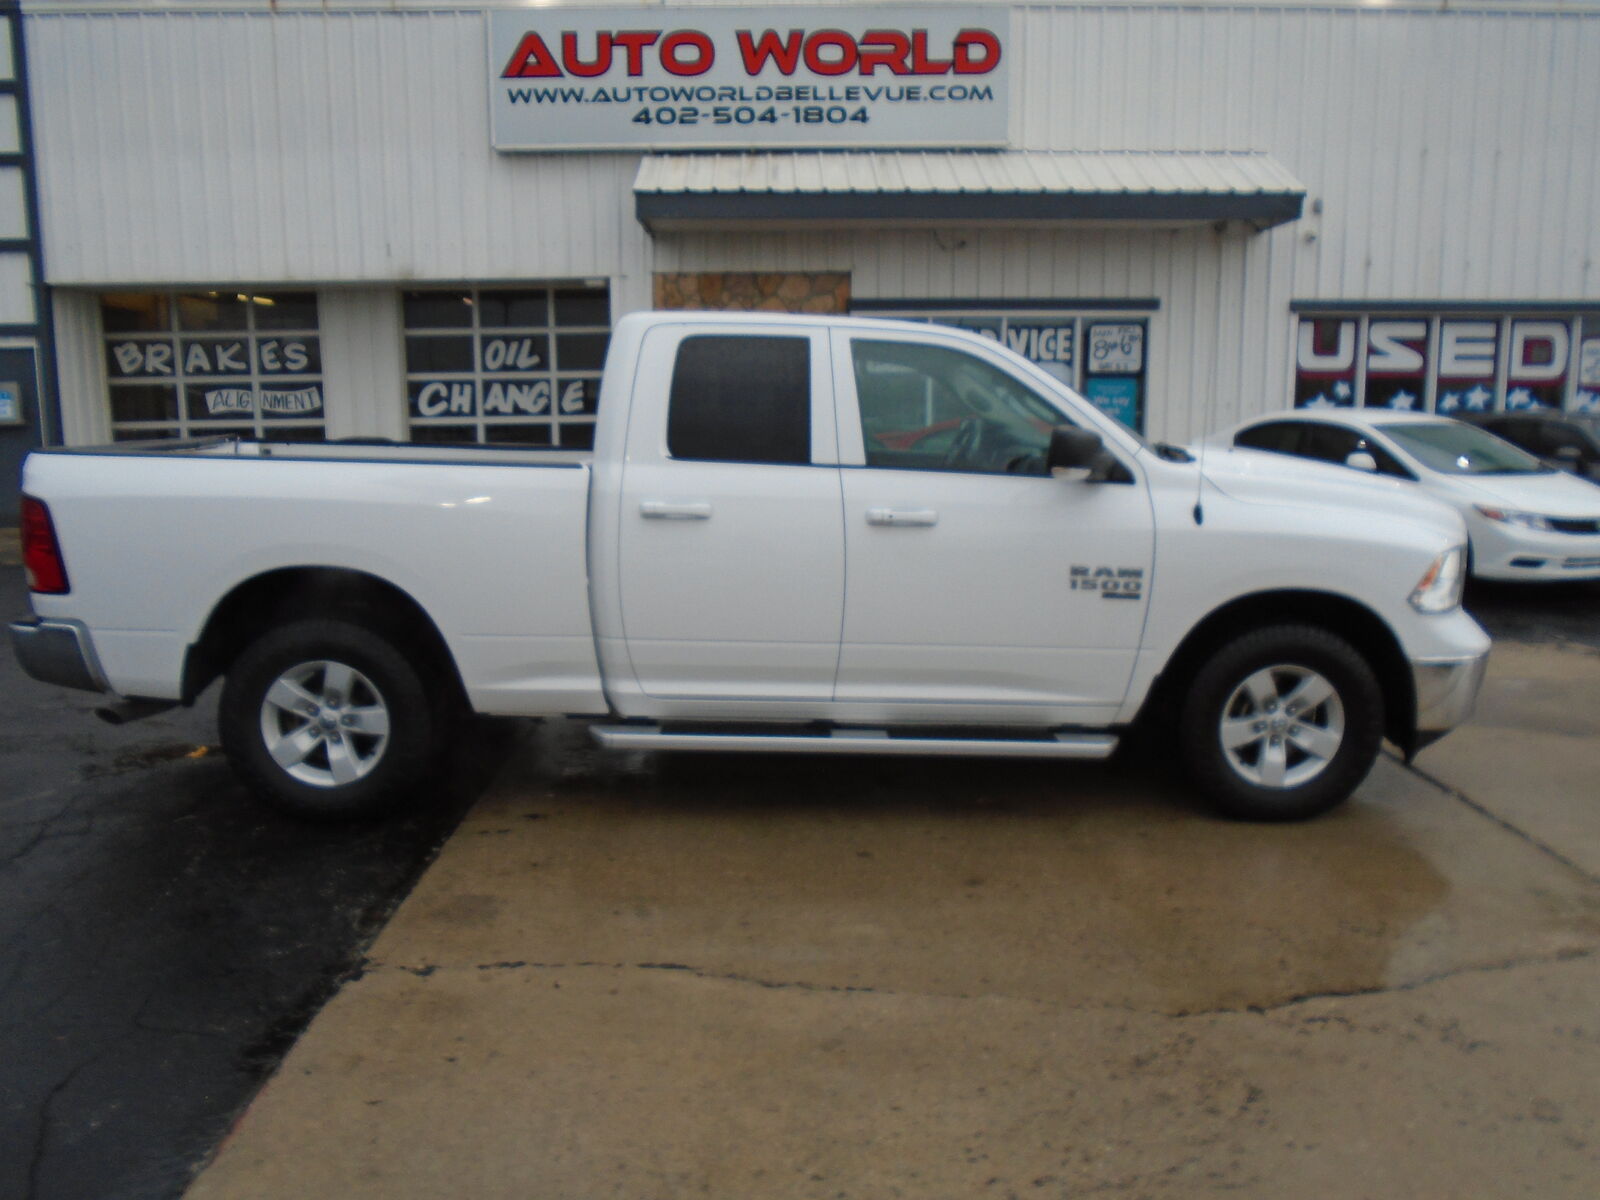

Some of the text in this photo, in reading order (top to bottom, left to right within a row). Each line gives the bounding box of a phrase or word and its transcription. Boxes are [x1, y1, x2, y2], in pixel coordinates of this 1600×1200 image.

[500, 28, 1002, 78] AUTO WORLD
[507, 85, 994, 104] WWW.AUTOWORLDBELLEVUE.COM
[632, 105, 870, 125] 402-504-1804
[113, 340, 309, 374] BRAKES
[485, 338, 540, 370] OIL
[978, 328, 1073, 361] VICE
[1297, 320, 1570, 381] USED
[212, 388, 317, 411] ALIGNMENT
[417, 379, 584, 417] CHANGE
[1070, 579, 1143, 592] 1500
